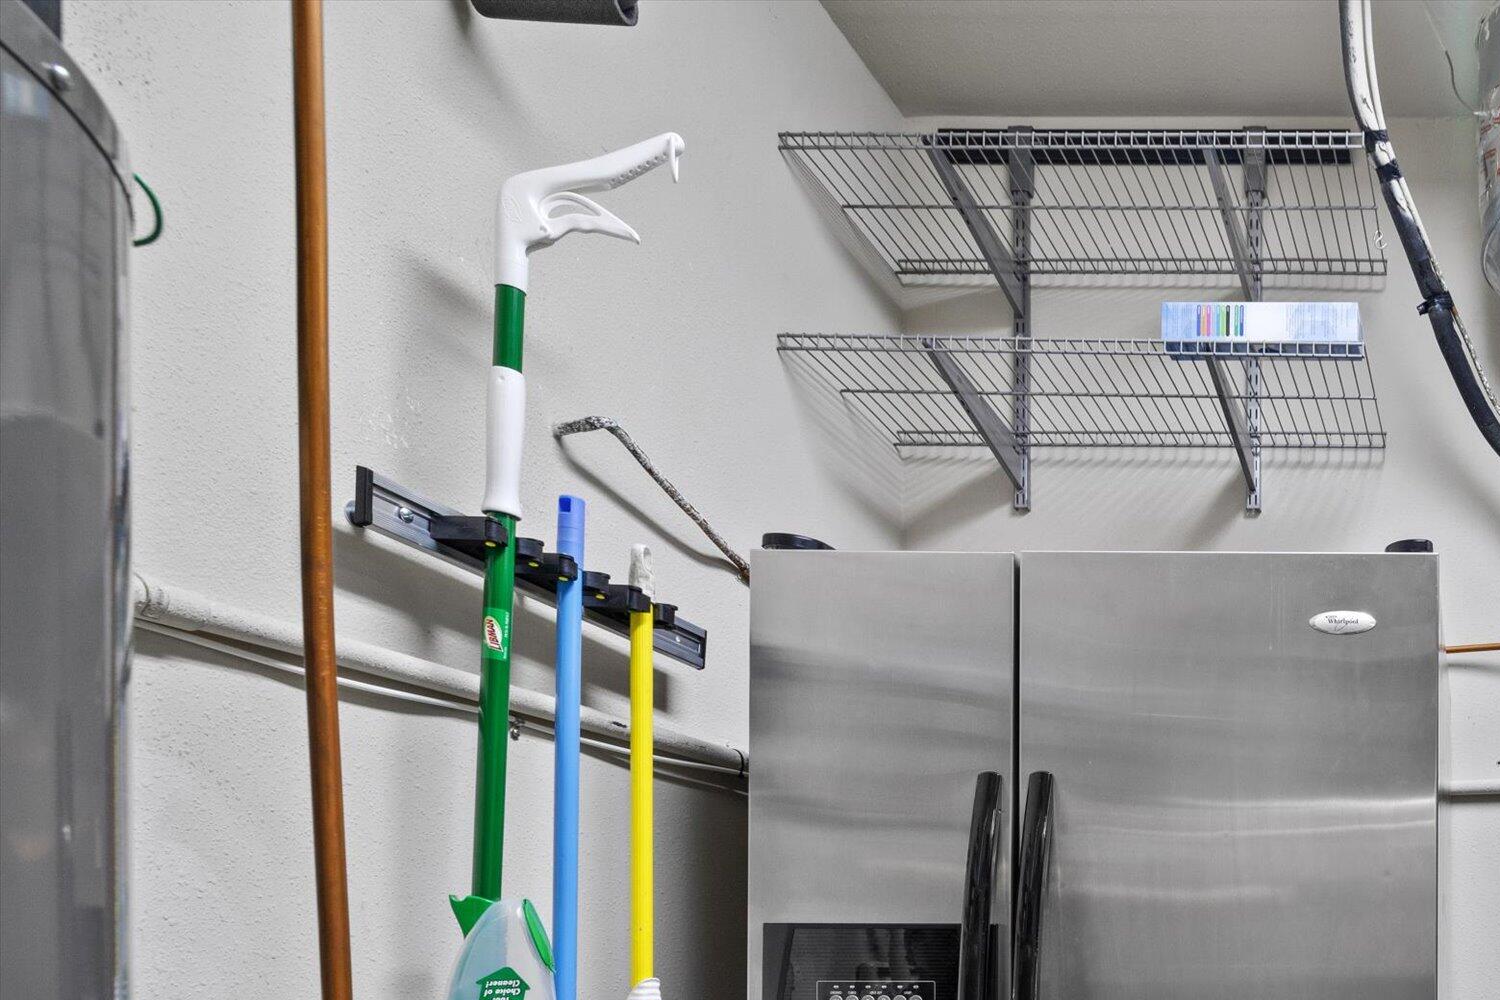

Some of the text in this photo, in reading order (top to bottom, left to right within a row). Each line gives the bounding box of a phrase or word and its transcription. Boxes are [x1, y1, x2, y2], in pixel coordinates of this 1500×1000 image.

[486, 618, 502, 650] LIBMAN
[485, 979, 520, 988] Cleaner!
[483, 987, 521, 997] Choice of
